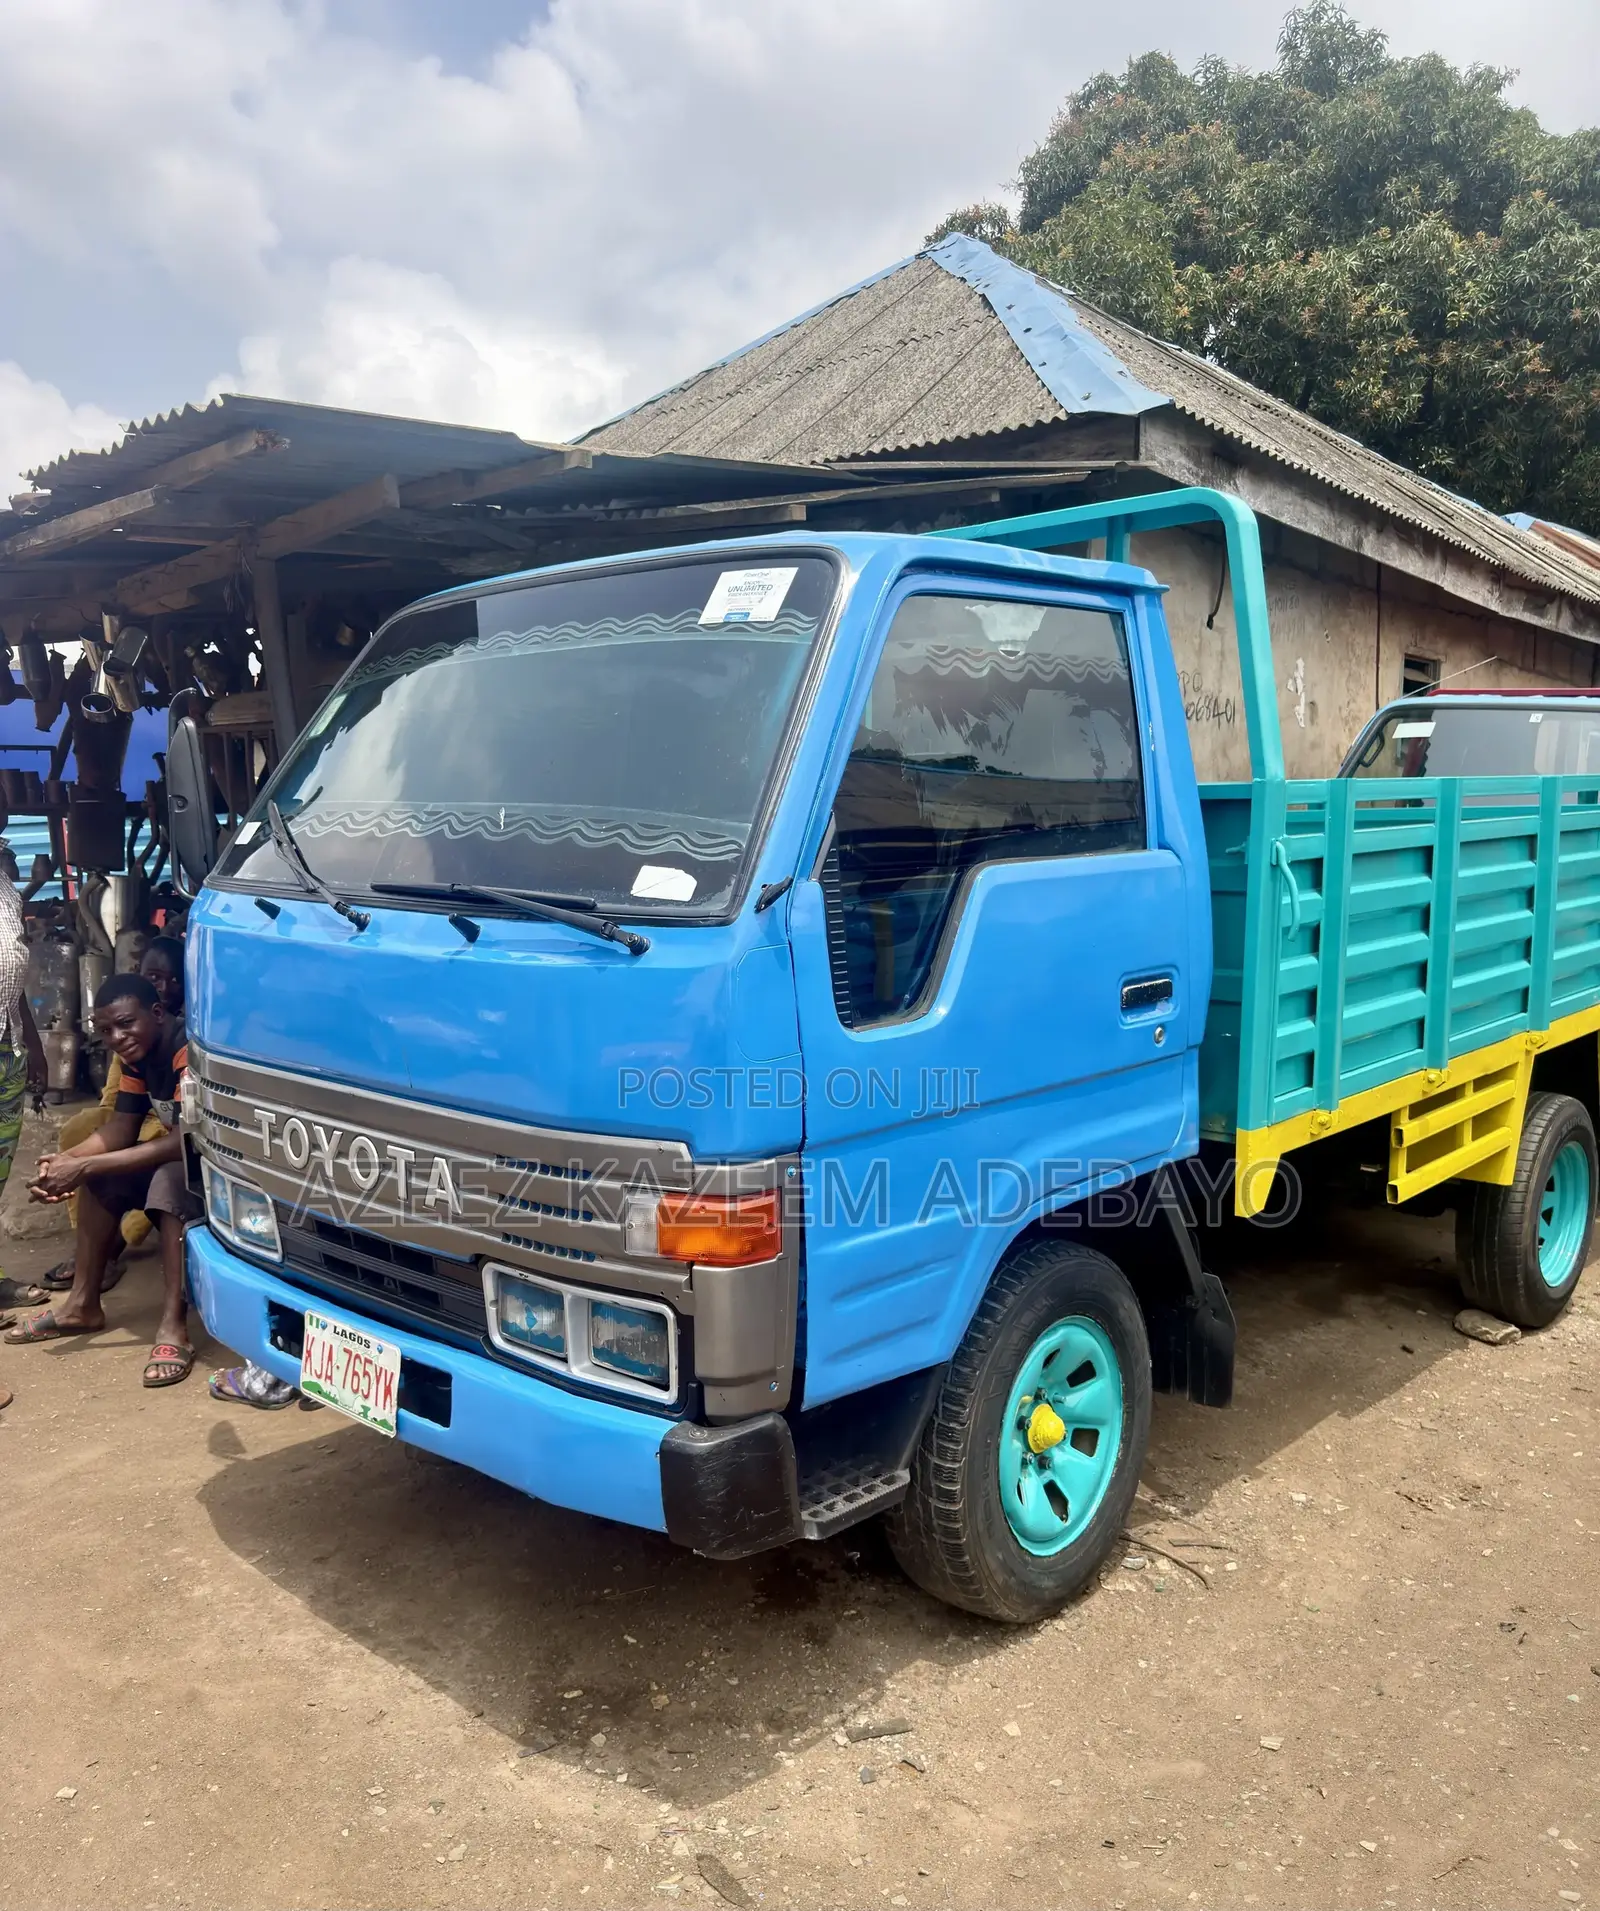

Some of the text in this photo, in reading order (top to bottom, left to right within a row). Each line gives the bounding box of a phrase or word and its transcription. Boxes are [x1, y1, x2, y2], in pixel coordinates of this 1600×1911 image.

[727, 584, 774, 593] UNLIMITED
[253, 1108, 463, 1216] TOYOTA
[333, 1325, 371, 1349] LAGOS
